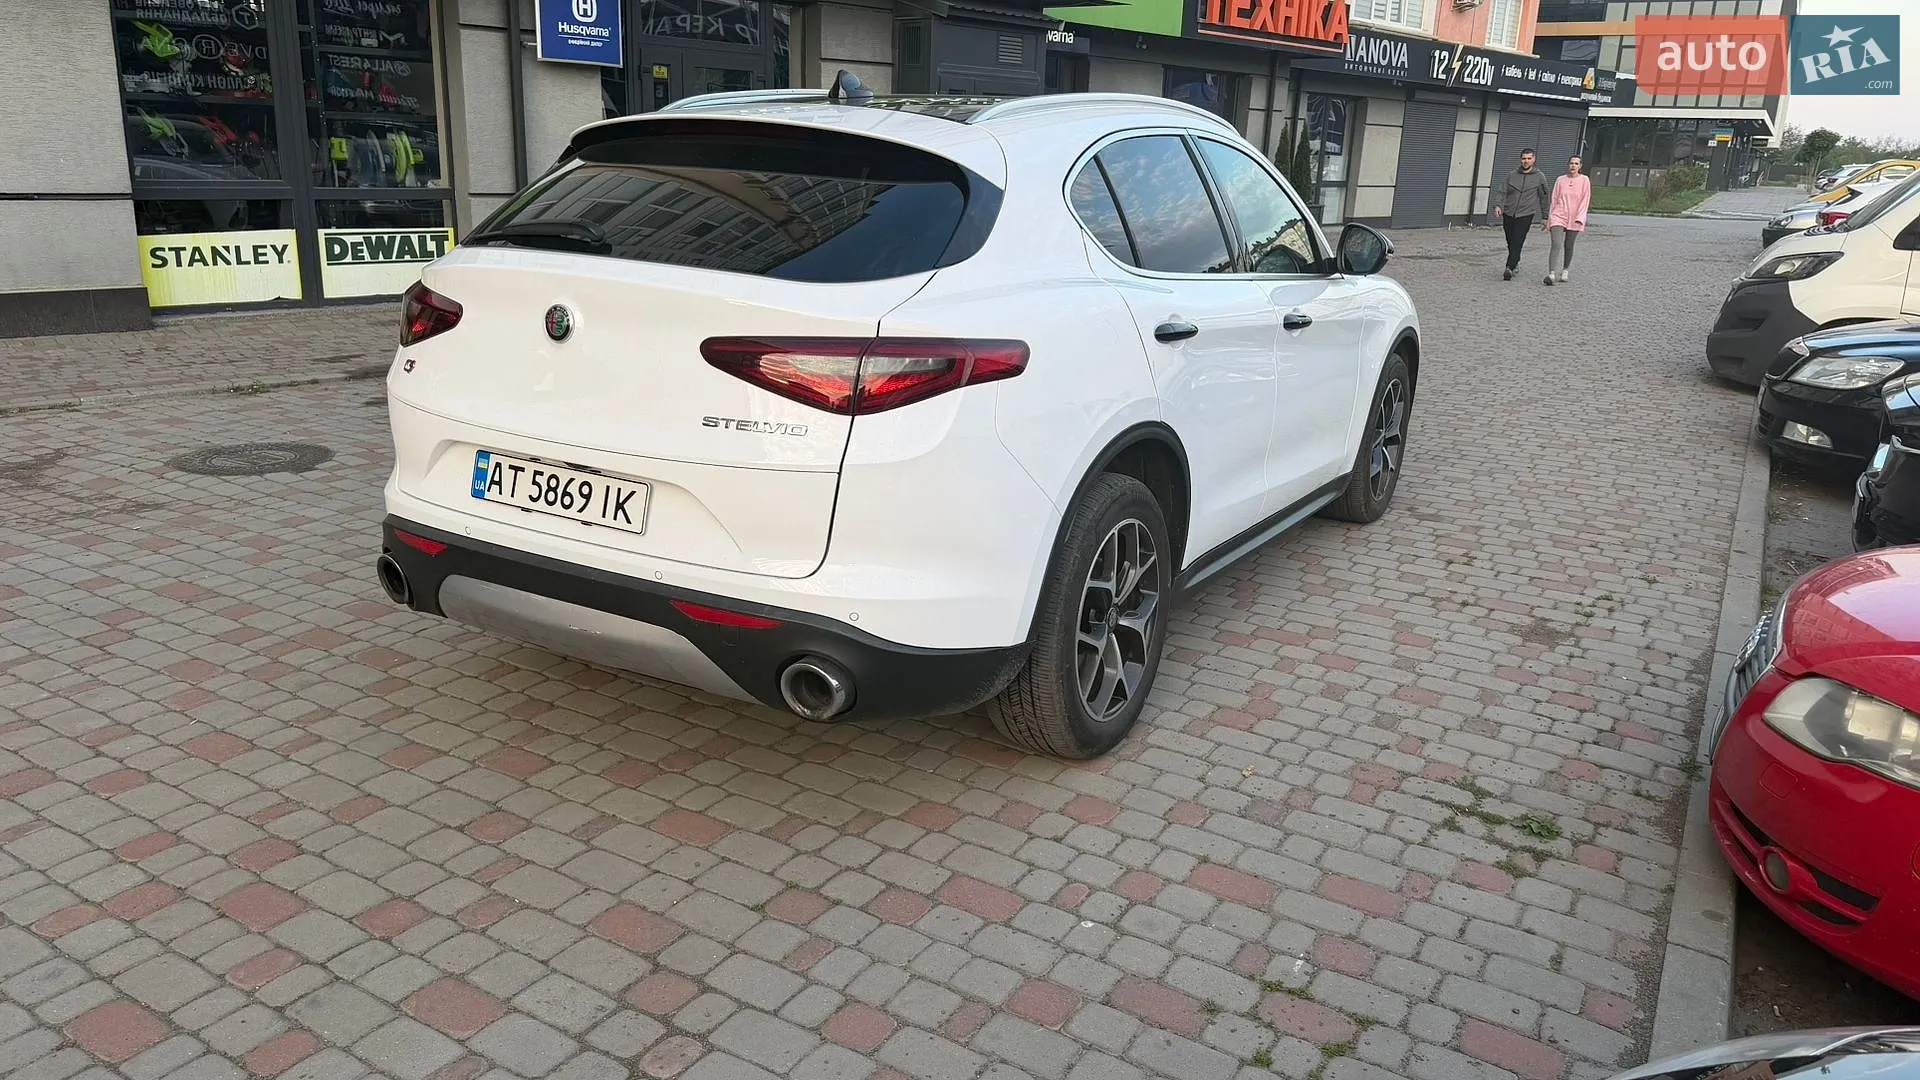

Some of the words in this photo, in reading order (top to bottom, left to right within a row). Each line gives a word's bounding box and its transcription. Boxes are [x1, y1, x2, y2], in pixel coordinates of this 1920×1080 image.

[558, 21, 611, 37] Husqvarna
[1432, 49, 1449, 80] 12
[150, 244, 290, 269] STANLEY
[701, 416, 809, 436] STELVIO
[474, 479, 485, 491] UA
[487, 461, 526, 498] AT
[528, 469, 593, 514] 5869
[601, 484, 637, 525] IK
